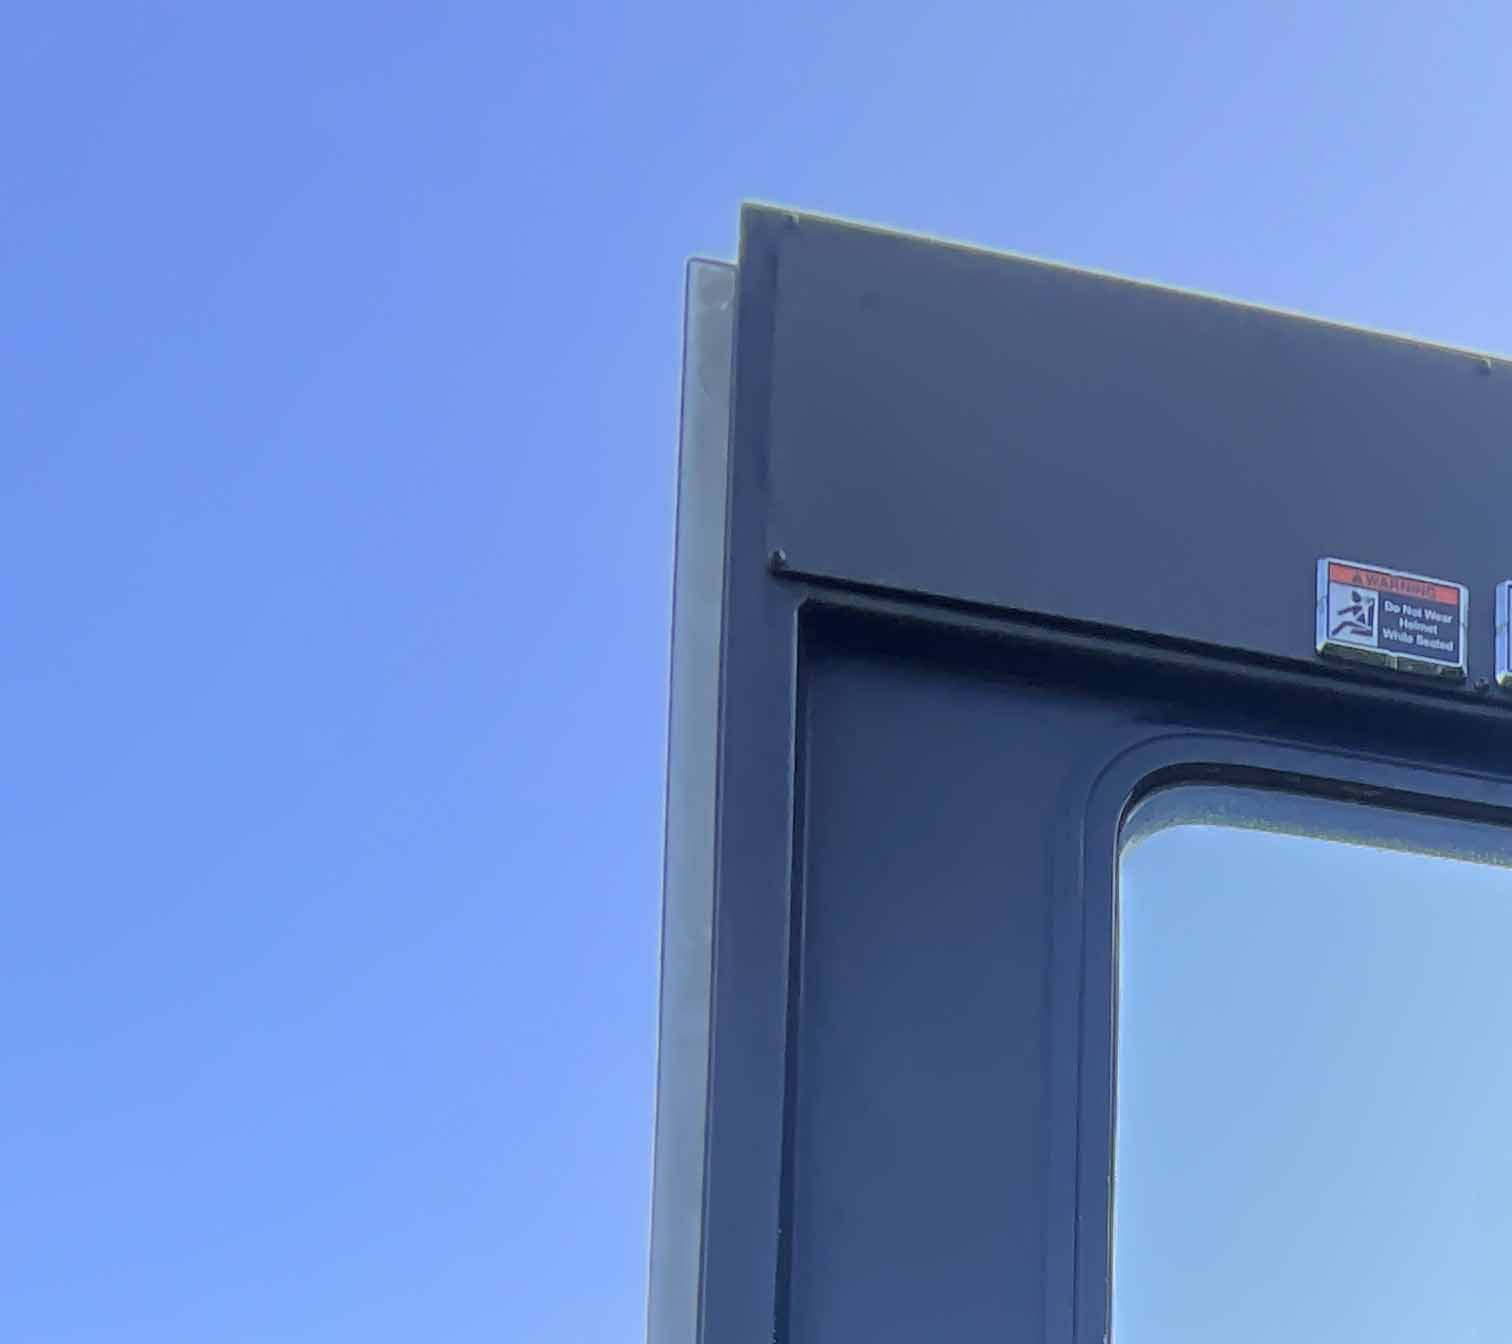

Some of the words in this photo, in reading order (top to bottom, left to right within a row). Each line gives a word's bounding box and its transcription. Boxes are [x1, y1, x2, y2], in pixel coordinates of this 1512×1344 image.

[1384, 600, 1400, 613] Do
[1402, 604, 1422, 618] Not
[1424, 609, 1453, 623] Wear
[1399, 617, 1437, 635] Helmet
[1383, 627, 1413, 643] While
[1416, 635, 1453, 652] Seated
